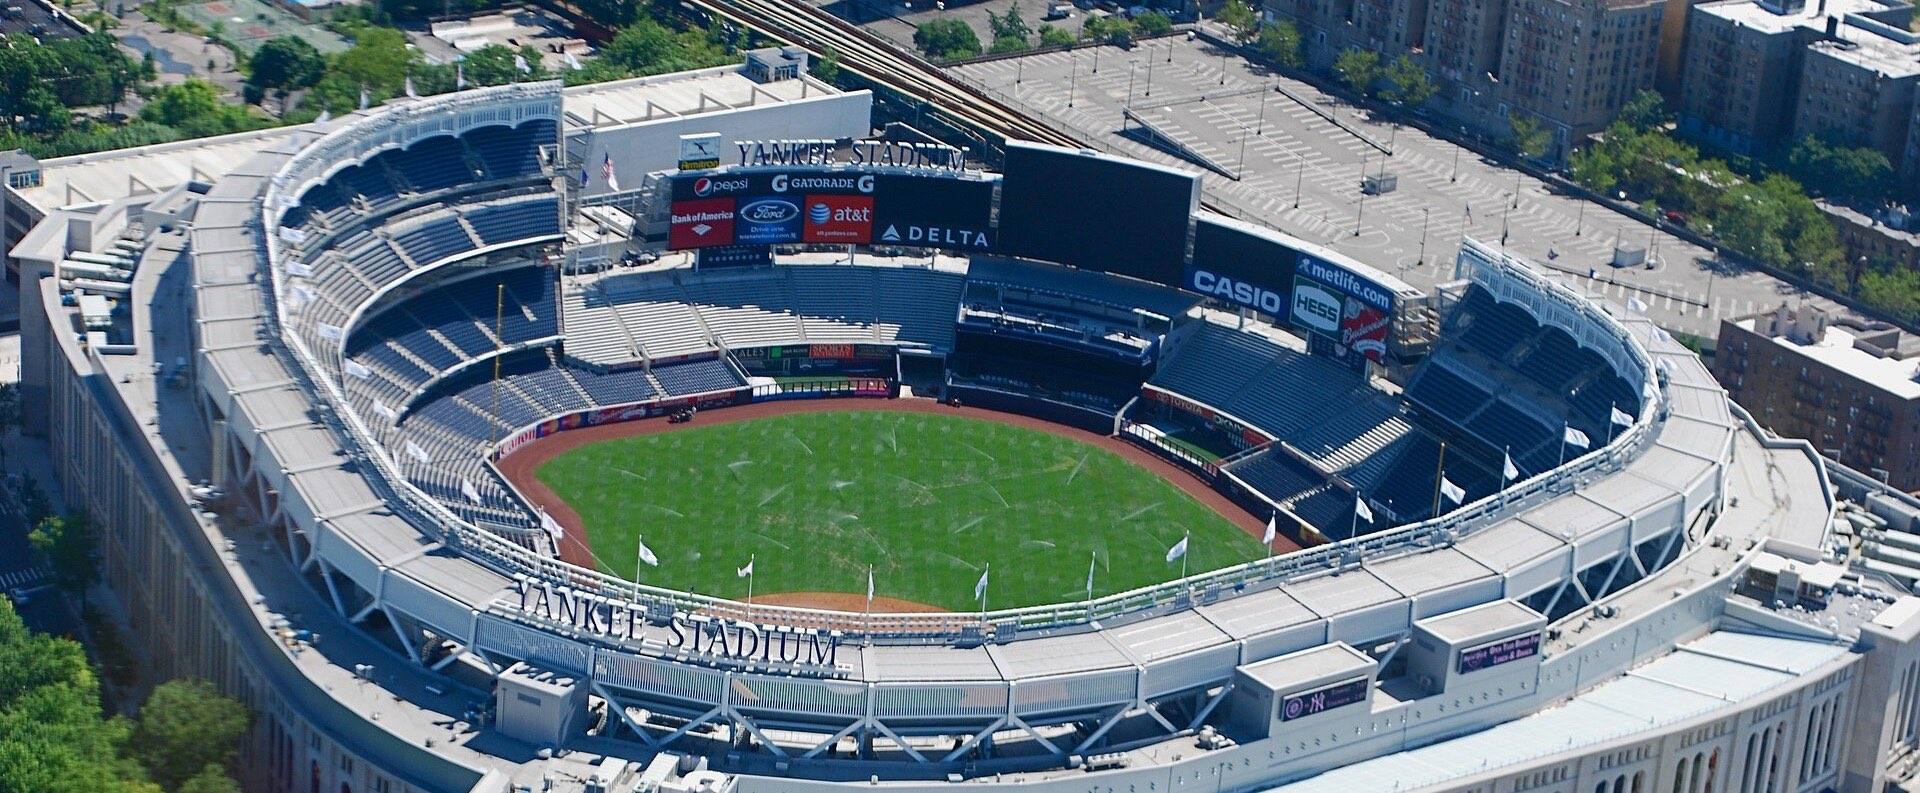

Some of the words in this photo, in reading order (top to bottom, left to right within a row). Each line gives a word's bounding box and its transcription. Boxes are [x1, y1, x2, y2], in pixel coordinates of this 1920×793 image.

[734, 139, 836, 168] YANKEE
[849, 140, 971, 172] STADIUM
[713, 178, 748, 192] pepsi
[771, 175, 788, 192] G
[791, 177, 854, 189] GATORADE
[857, 175, 874, 193] G
[672, 214, 691, 224] Bank
[692, 213, 701, 222] of
[701, 211, 734, 221] America
[753, 205, 786, 219] Ford
[834, 207, 870, 222] at&t
[909, 226, 988, 247] DELTA
[1194, 270, 1281, 313] CASIO
[1312, 264, 1390, 309] metlife.com
[1296, 293, 1338, 320] HESS
[1170, 397, 1202, 415] TOYOTA
[513, 572, 648, 642] YANKEE
[667, 611, 841, 666] STADIUM
